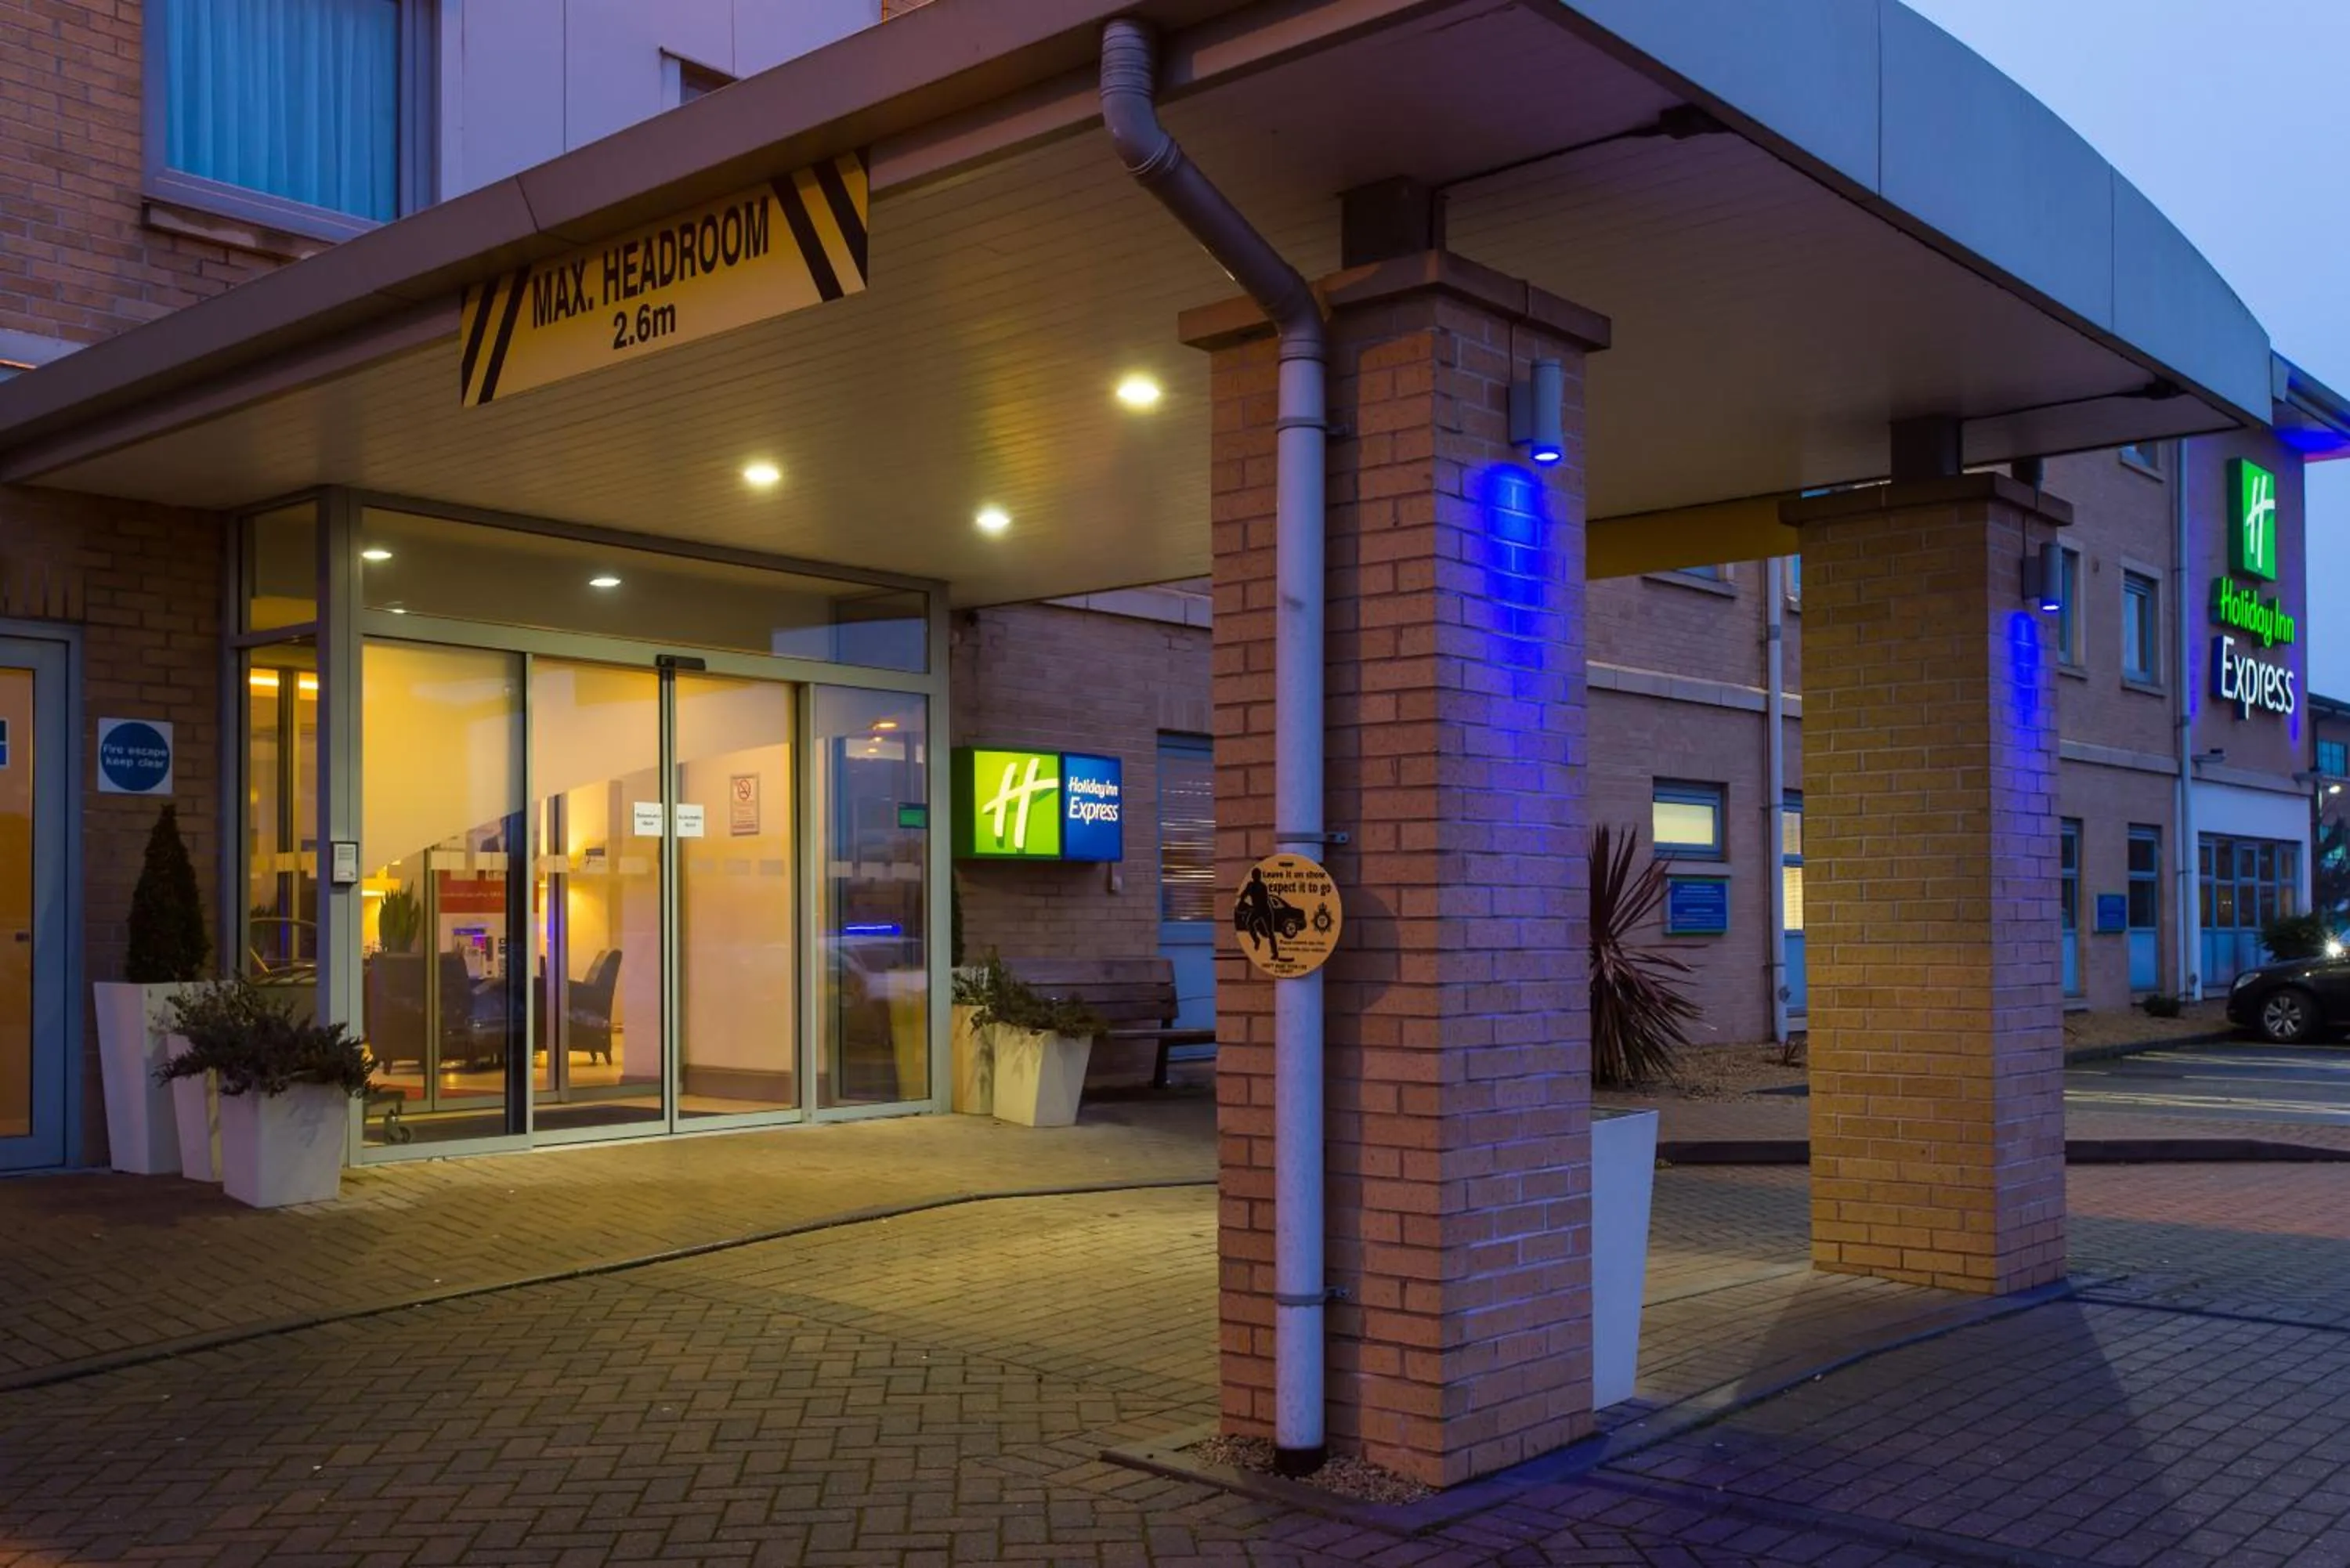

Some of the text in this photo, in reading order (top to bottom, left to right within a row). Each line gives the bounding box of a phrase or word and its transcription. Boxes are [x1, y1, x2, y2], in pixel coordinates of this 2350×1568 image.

[533, 196, 769, 328] MAX. HEADROOM
[613, 302, 676, 349] 2.6m
[2221, 576, 2294, 648] Holiday Inn
[2221, 635, 2294, 720] Express
[103, 744, 167, 757] Fire escape
[106, 756, 164, 768] keep clear
[1068, 776, 1119, 798] Holiday Inn
[1069, 796, 1119, 824] Express
[1268, 882, 1331, 896] expect it to go
